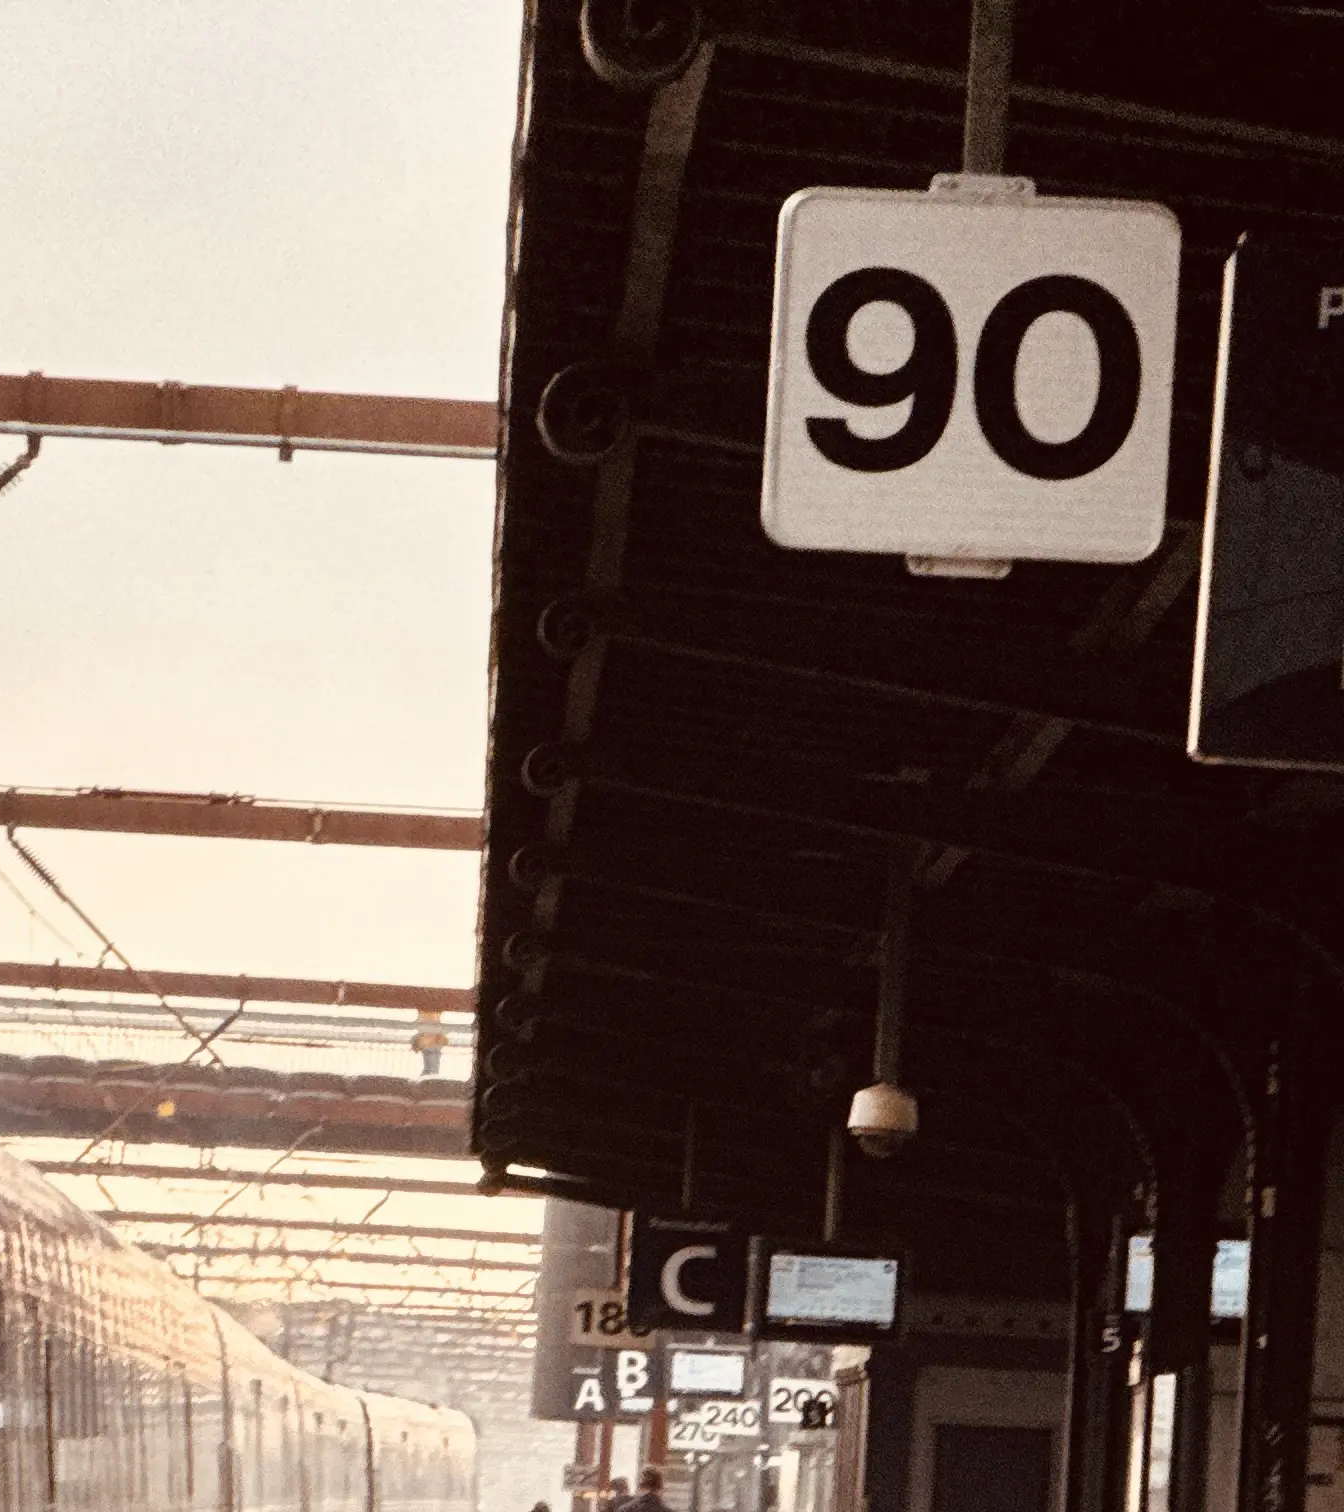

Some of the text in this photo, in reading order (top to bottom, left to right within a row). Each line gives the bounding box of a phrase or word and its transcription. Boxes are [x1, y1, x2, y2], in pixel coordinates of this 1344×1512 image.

[805, 267, 1141, 481] 90
[662, 1246, 716, 1316] C
[575, 1302, 652, 1337] 18
[1102, 1328, 1121, 1352] 5
[617, 1350, 649, 1390] B
[574, 1378, 605, 1411] A
[707, 1405, 759, 1428] 240
